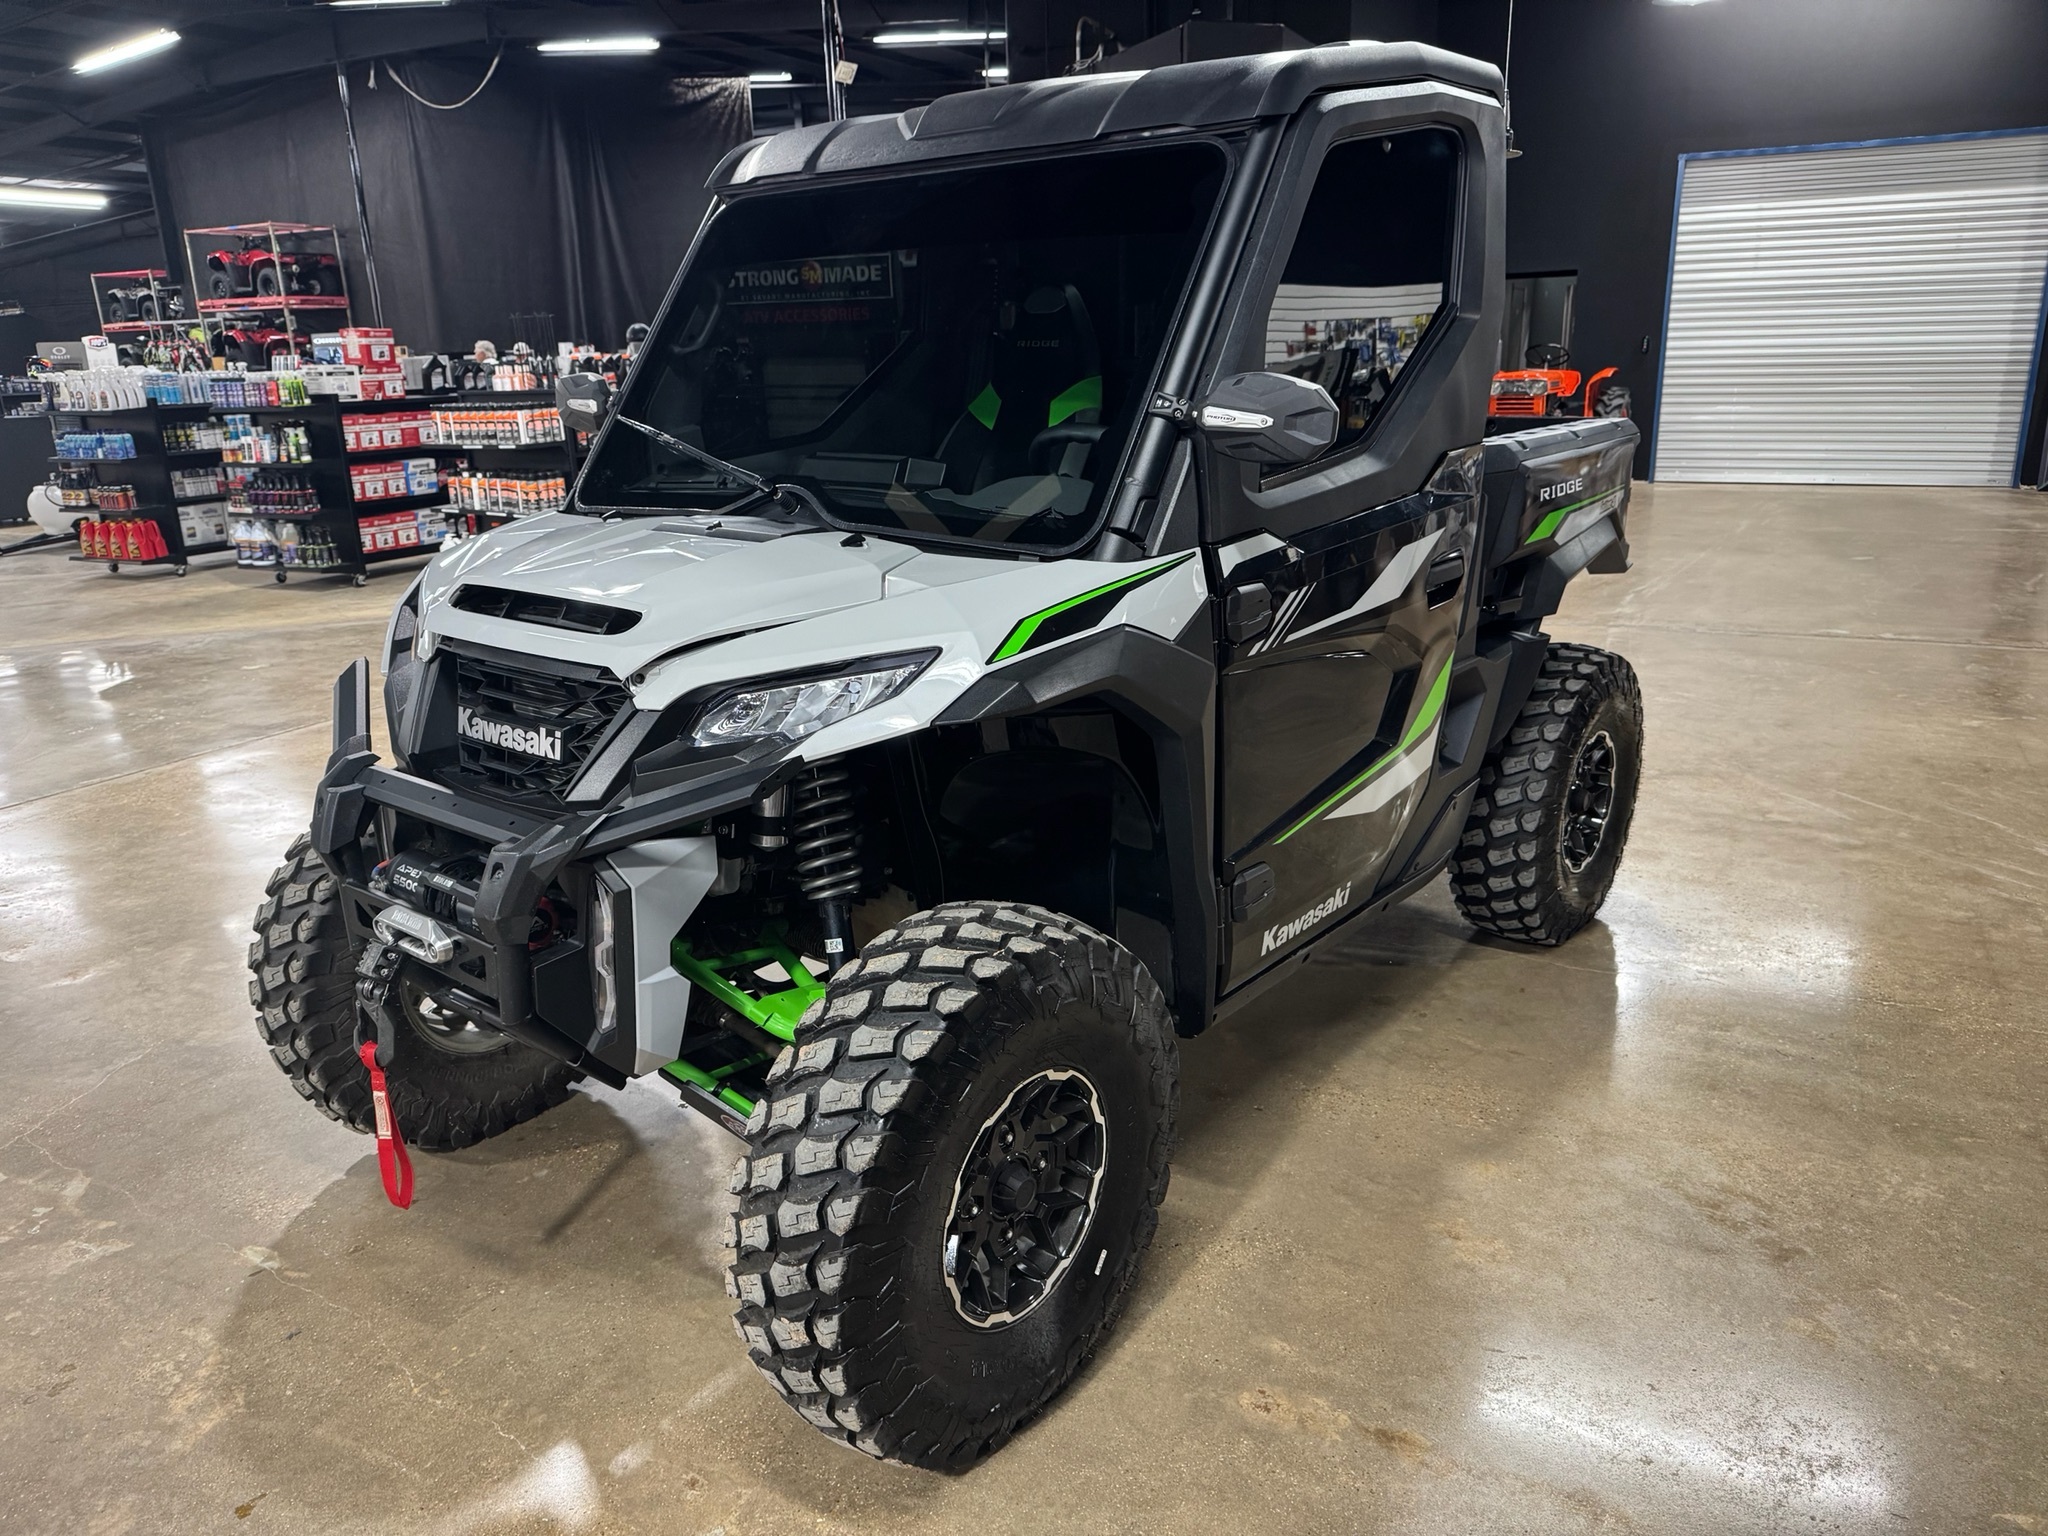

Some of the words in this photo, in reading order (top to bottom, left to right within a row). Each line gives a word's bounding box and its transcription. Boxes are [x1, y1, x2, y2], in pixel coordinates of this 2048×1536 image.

[824, 264, 882, 283] MADE
[744, 310, 769, 324] ATV
[774, 306, 870, 324] ACCESSORIES
[1016, 339, 1060, 348] RIDGE
[1540, 478, 1583, 502] RIDGE
[458, 705, 561, 761] Kawasaki
[1260, 880, 1352, 957] Kawasaki
